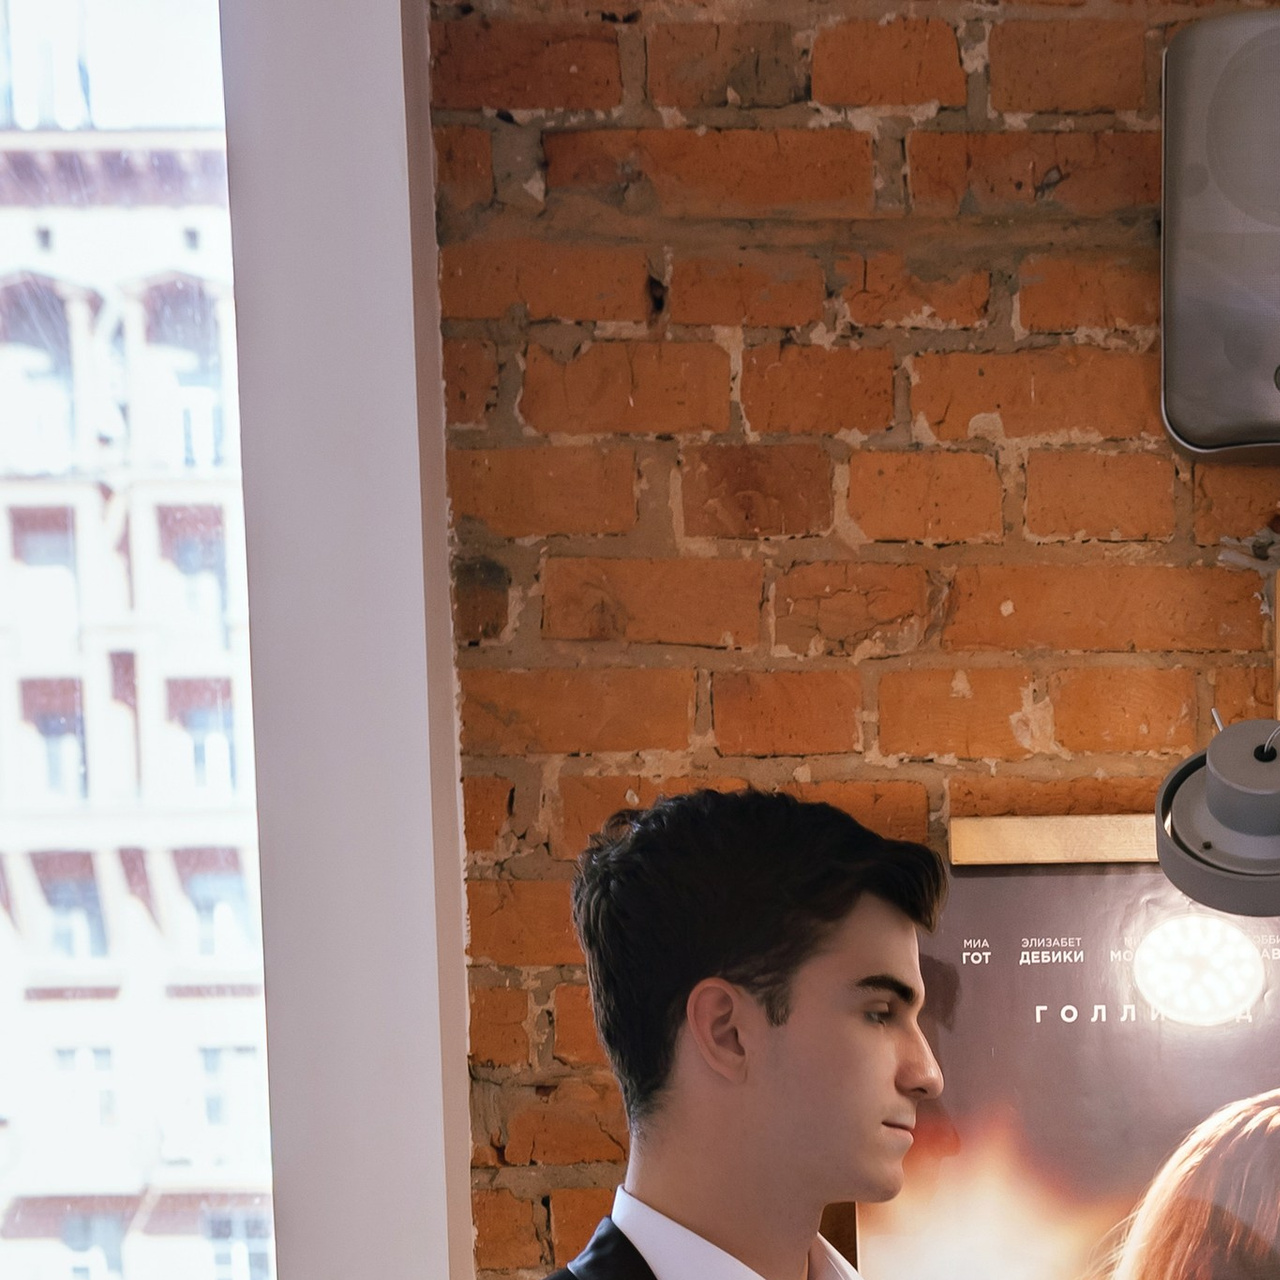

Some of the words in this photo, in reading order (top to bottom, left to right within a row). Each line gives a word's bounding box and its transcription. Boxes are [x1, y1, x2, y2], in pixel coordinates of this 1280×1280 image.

[963, 939, 990, 948] МИА
[1021, 937, 1082, 947] ЭЛИЗАБЕТ
[962, 952, 991, 964] ГОТ
[1019, 951, 1084, 965] ДЕБИКИ
[1035, 1004, 1253, 1023] ГОЛЛИД
